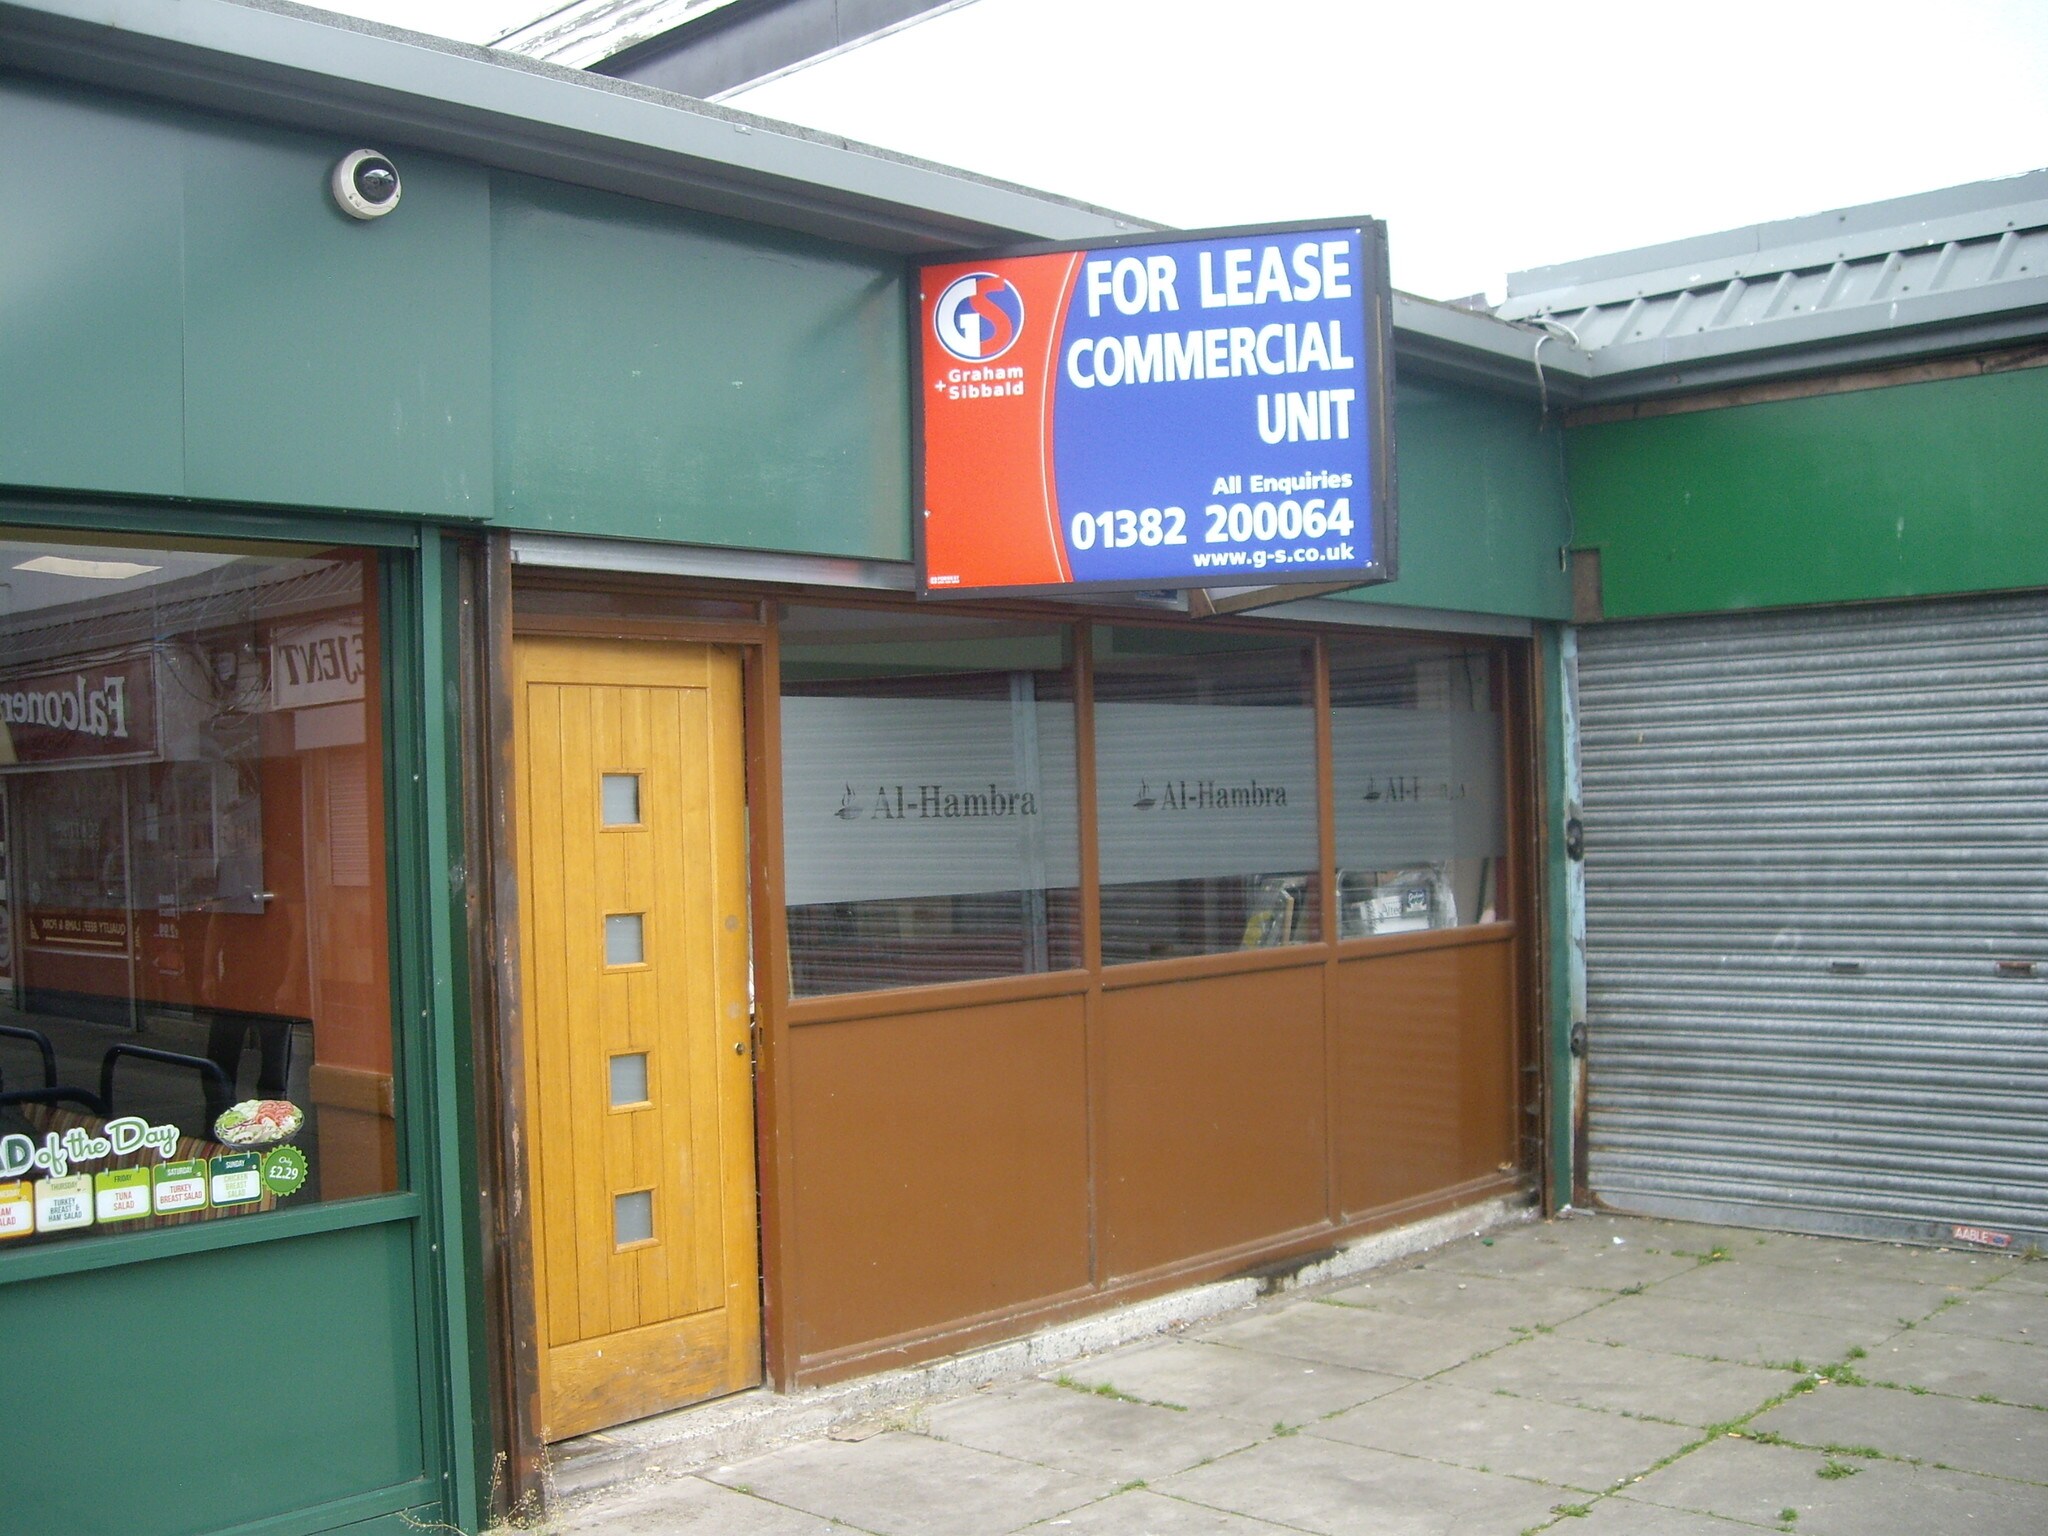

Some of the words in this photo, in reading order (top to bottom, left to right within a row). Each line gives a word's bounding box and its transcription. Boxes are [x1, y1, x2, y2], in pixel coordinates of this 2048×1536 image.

[1086, 254, 1180, 318] FOR
[1199, 240, 1352, 309] LEASE
[1066, 319, 1355, 390] COMMERCIAL
[947, 366, 1024, 383] Graham
[948, 380, 1025, 400] Sibbald
[1256, 388, 1356, 445] UNIT
[1212, 474, 1242, 496] All
[1250, 469, 1353, 496] Enquiries
[1071, 506, 1188, 551] 01382
[1204, 497, 1355, 544] 200064
[1192, 542, 1355, 569] www.g-s.co.uk
[870, 783, 1038, 820] Al-Hambra
[1161, 779, 1288, 811] Al-Hambra
[36, 1134, 66, 1176] of
[65, 1130, 109, 1160] the
[107, 1118, 179, 1157] Day
[114, 1174, 132, 1182] FRIDAY
[269, 1165, 299, 1180] £2.29
[50, 1181, 78, 1191] THURSDAY
[170, 1184, 192, 1193] TURKEY
[53, 1197, 76, 1206] TURKEY
[115, 1191, 132, 1201] TUNA
[160, 1193, 183, 1204] BREAST
[184, 1190, 203, 1201] SALAD
[50, 1204, 72, 1214] BREAST
[113, 1200, 135, 1211] SALAD
[48, 1214, 63, 1222] HAM
[63, 1211, 83, 1221] SALAD
[1953, 1227, 1989, 1244] AABLE
